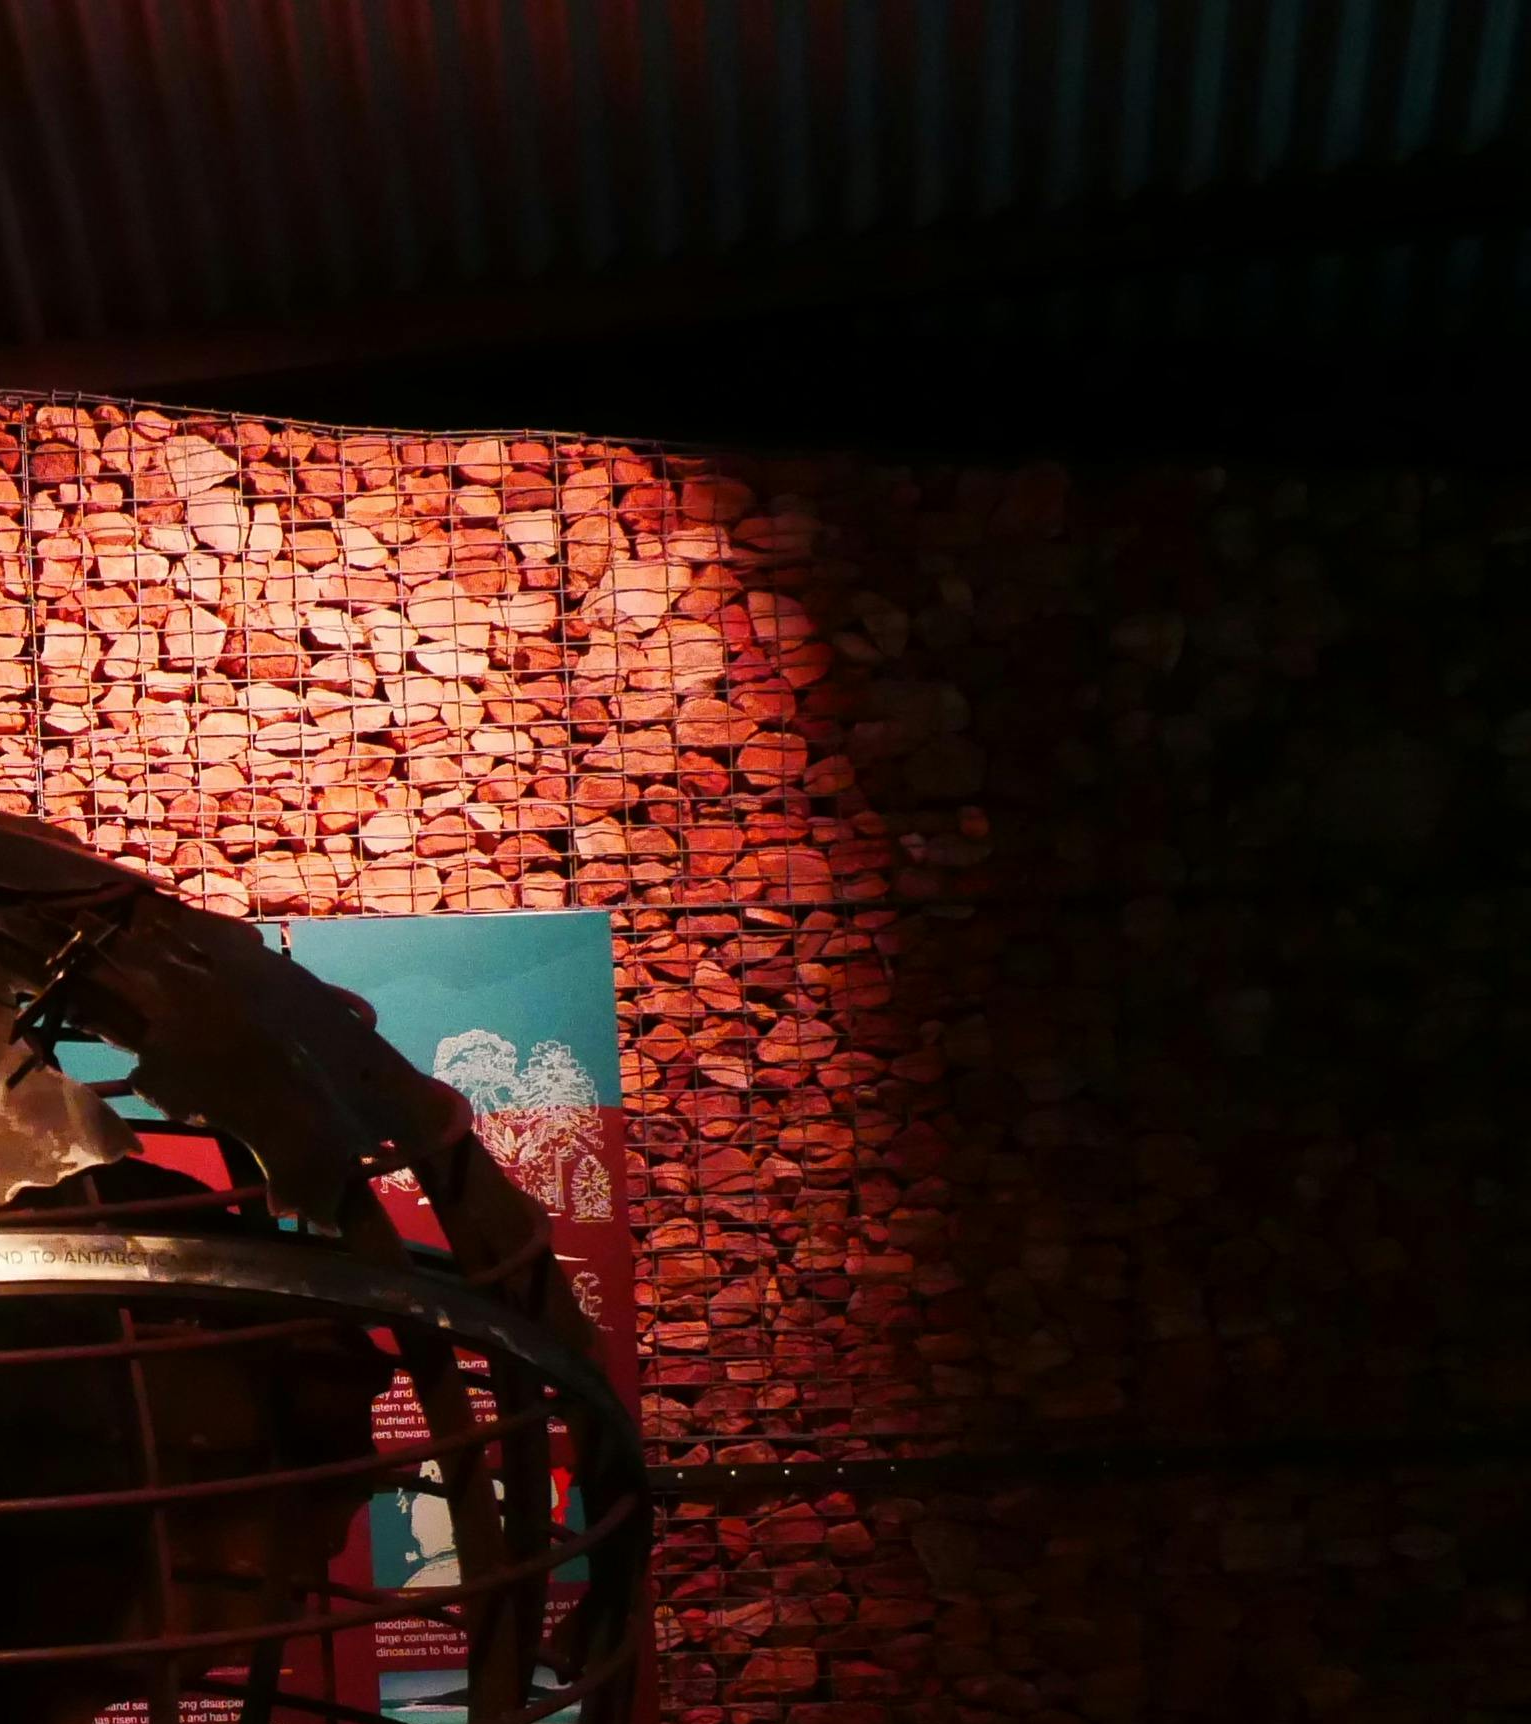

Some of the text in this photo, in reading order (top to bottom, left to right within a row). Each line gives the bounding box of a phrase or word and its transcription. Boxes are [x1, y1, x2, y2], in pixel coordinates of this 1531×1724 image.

[30, 1249, 57, 1265] TO
[392, 1387, 413, 1398] and
[376, 1416, 416, 1426] nutrient
[546, 1423, 567, 1434] Sea
[375, 1632, 457, 1644] large coniferous
[376, 1646, 440, 1657] dinosaurs to
[112, 1714, 138, 1724] risen
[188, 1712, 228, 1723] and has
